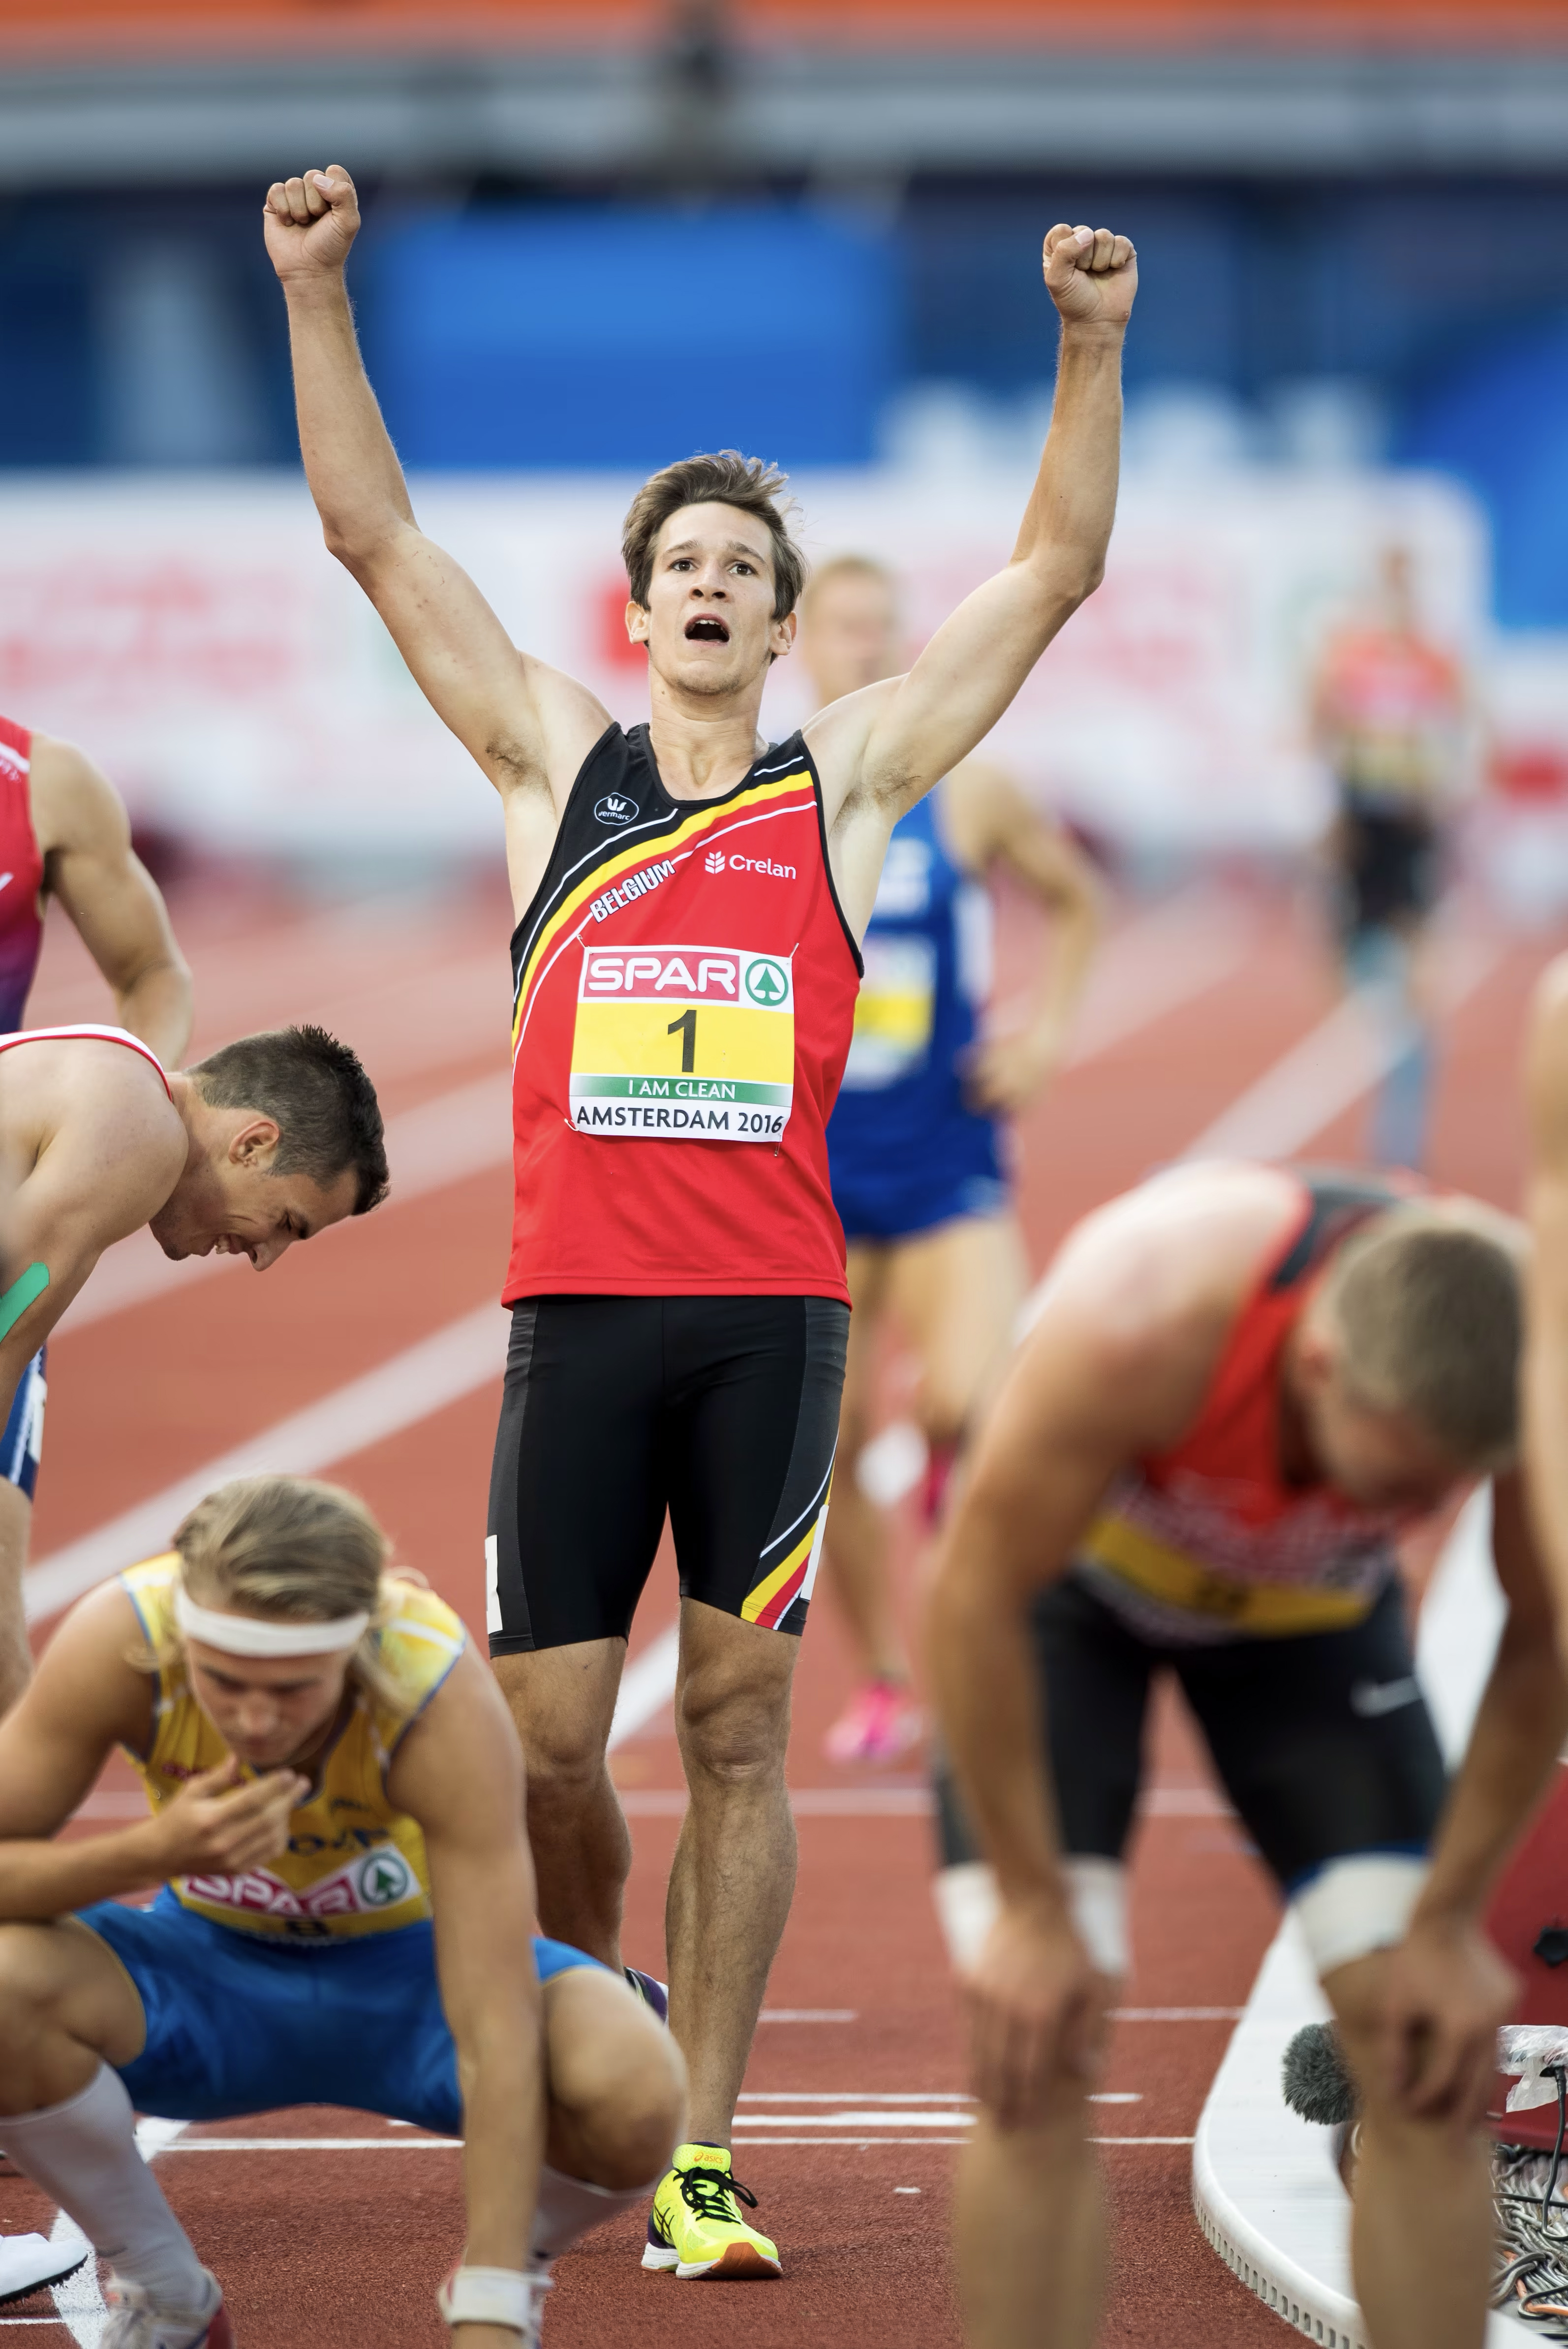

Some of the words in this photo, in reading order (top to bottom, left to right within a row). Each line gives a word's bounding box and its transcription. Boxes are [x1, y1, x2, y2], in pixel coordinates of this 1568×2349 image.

[598, 811, 630, 820] vermarc
[729, 854, 797, 880] Crelan
[589, 859, 676, 923] BELGIUM
[588, 957, 736, 995] SPAR
[667, 1009, 697, 1073] 1
[628, 1079, 633, 1095] I
[639, 1080, 669, 1096] AM
[675, 1081, 736, 1099] CLEAN
[577, 1106, 729, 1130] AMSTERDAM
[738, 1112, 785, 1133] 2016
[704, 2155, 723, 2164] asics
